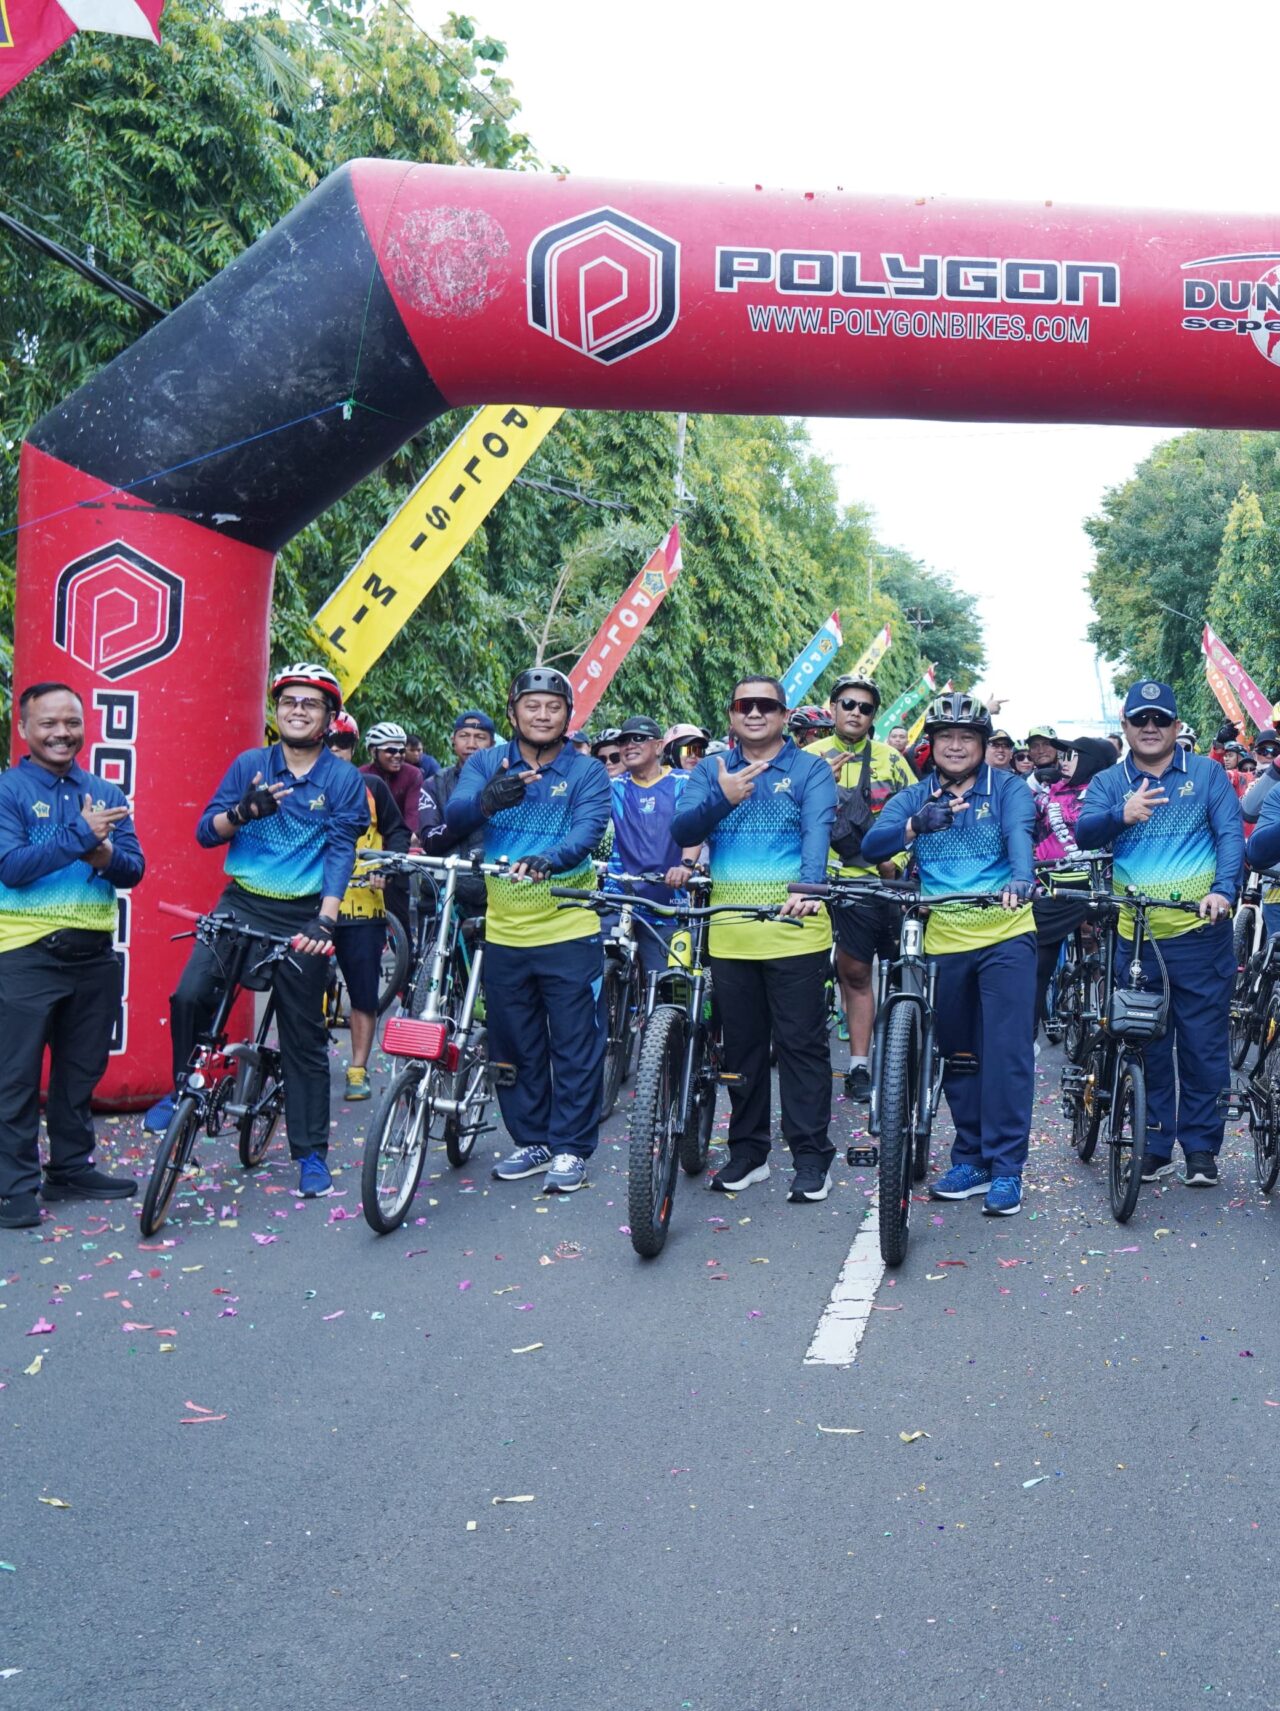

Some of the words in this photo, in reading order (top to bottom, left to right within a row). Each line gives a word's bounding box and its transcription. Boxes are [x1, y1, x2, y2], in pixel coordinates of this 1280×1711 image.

[715, 246, 1121, 307] POLYGON
[747, 304, 1090, 343] WWW.POLYGONBIKES.COM
[410, 407, 529, 552] POLISI
[577, 591, 651, 694] POLISI
[786, 652, 822, 700] POLI
